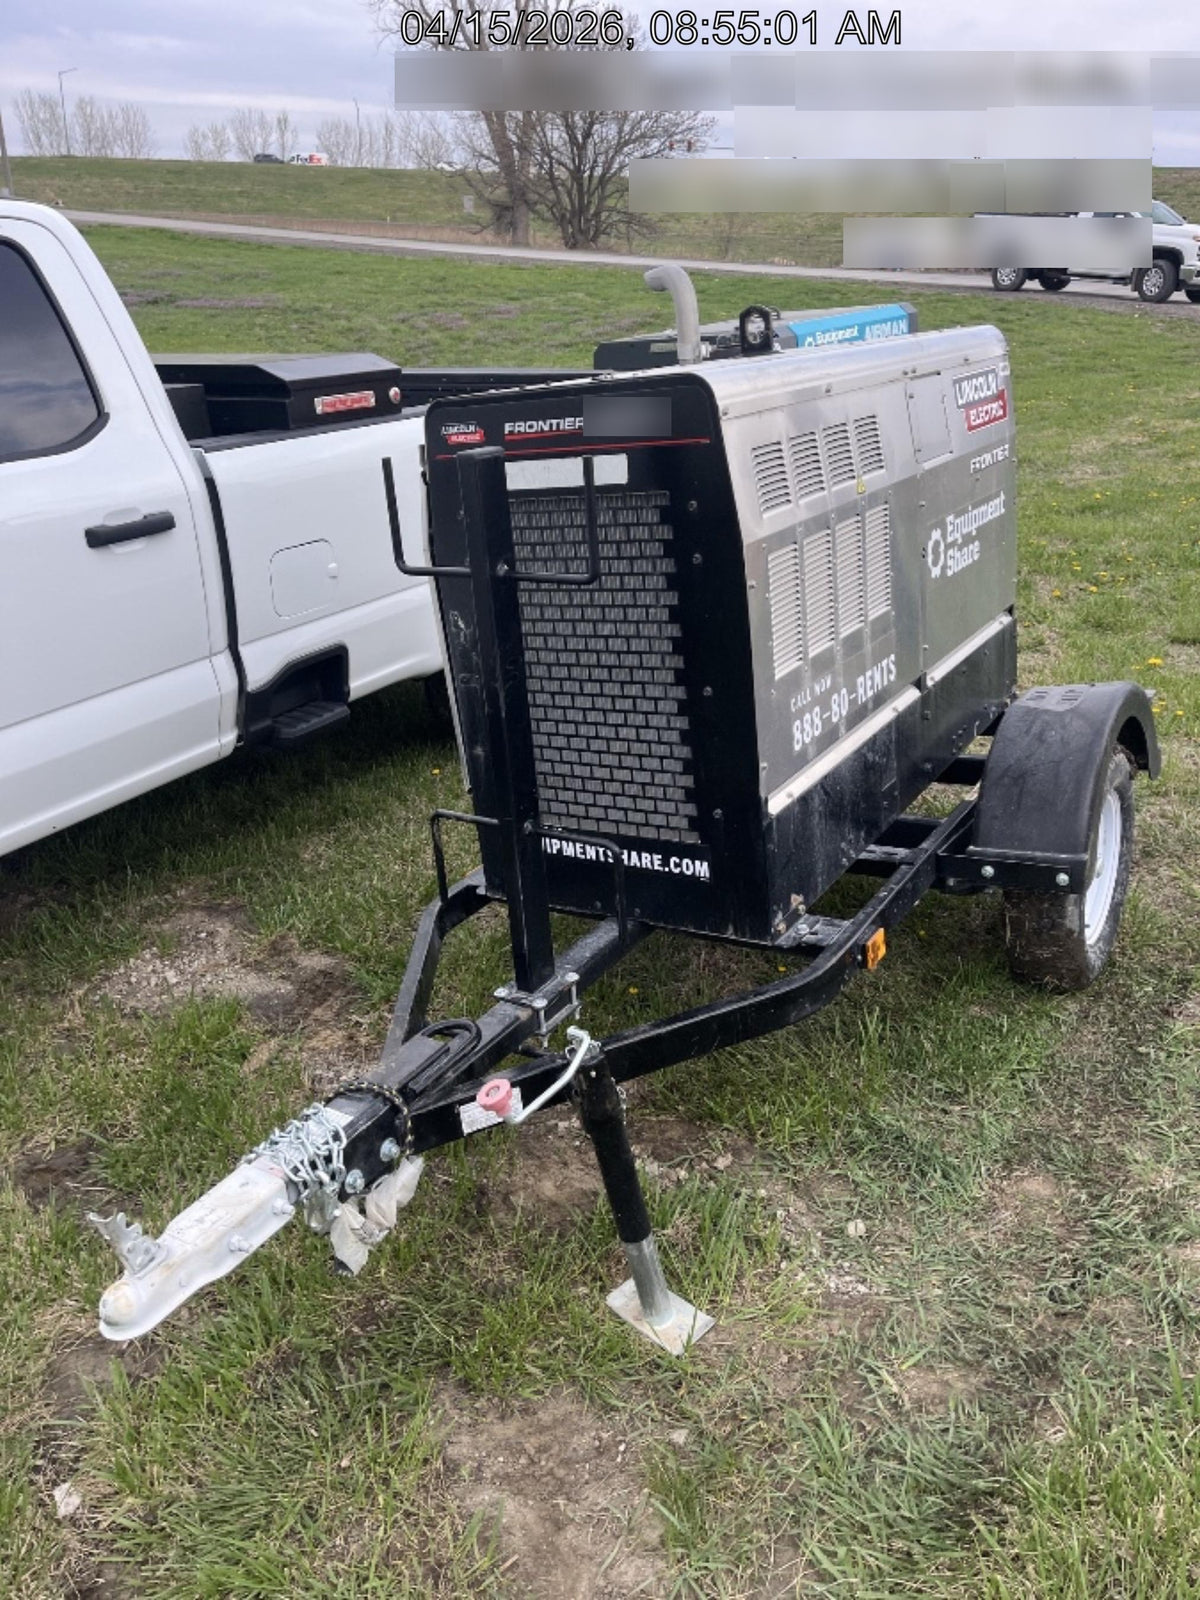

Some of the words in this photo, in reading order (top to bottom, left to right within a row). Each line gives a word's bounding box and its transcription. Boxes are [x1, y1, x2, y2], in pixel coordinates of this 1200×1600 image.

[864, 318, 909, 340] AIRMAN
[956, 372, 998, 406] LINCOLN
[504, 417, 583, 434] FRONTIER
[969, 399, 1004, 426] ELECTRIC
[945, 491, 1005, 543] Equipment
[946, 539, 980, 577] Share
[792, 653, 897, 751] 888-80-RENTS
